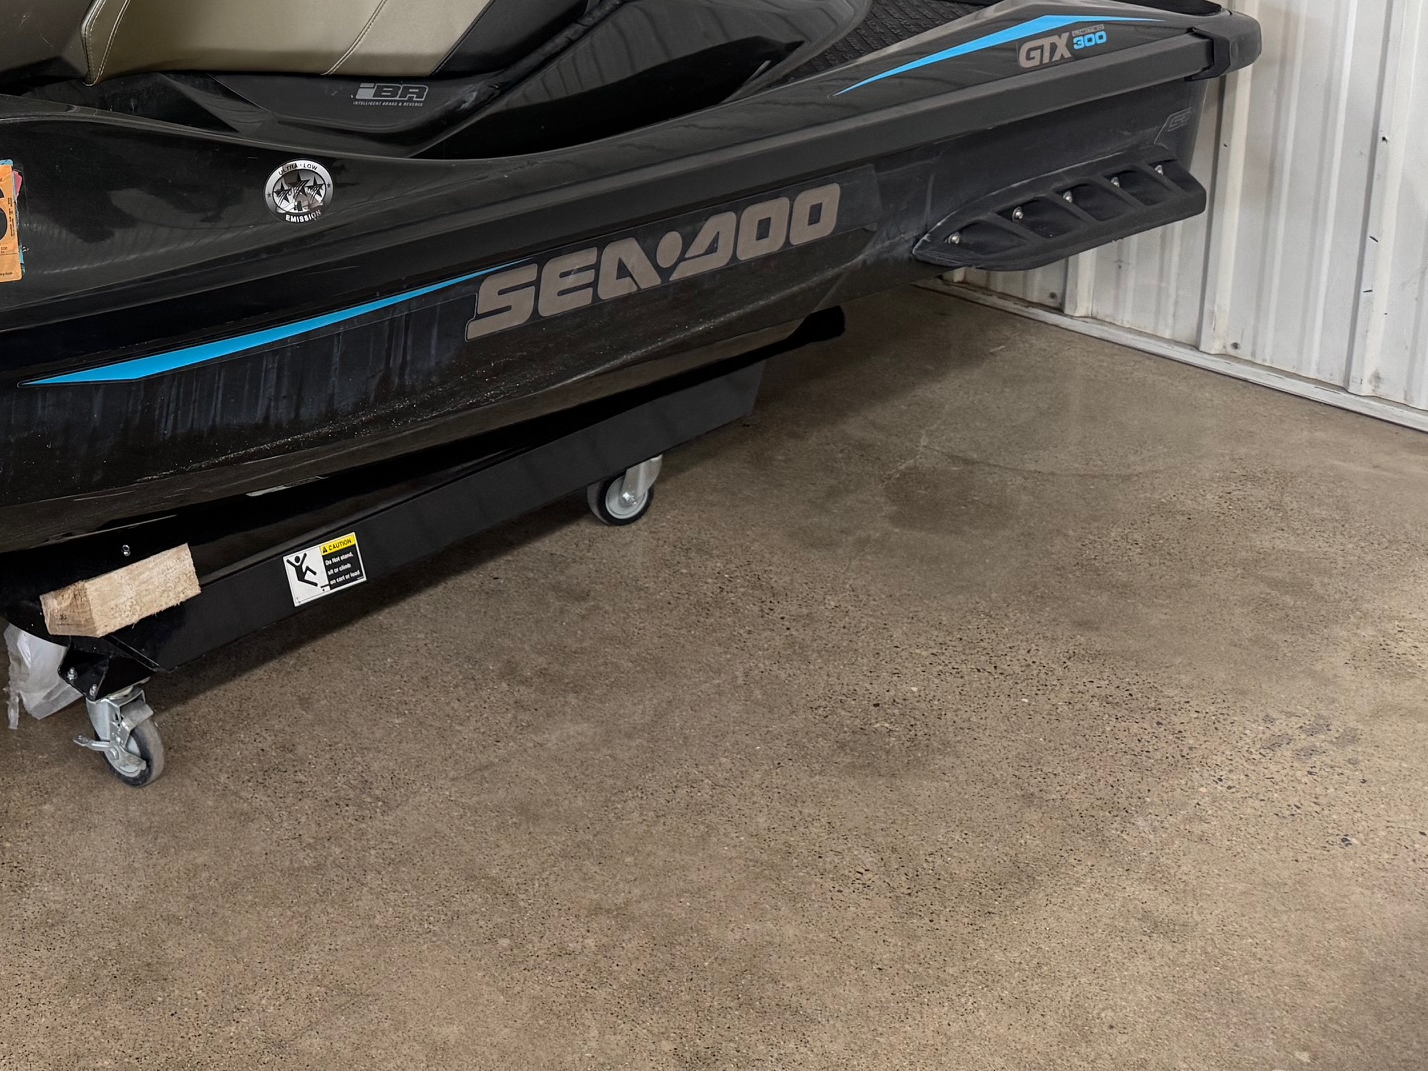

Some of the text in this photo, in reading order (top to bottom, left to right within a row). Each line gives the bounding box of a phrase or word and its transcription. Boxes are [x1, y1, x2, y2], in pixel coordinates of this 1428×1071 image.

[1018, 30, 1107, 68] GTX 300
[285, 209, 322, 223] EMISSION
[328, 537, 352, 551] CAUTION
